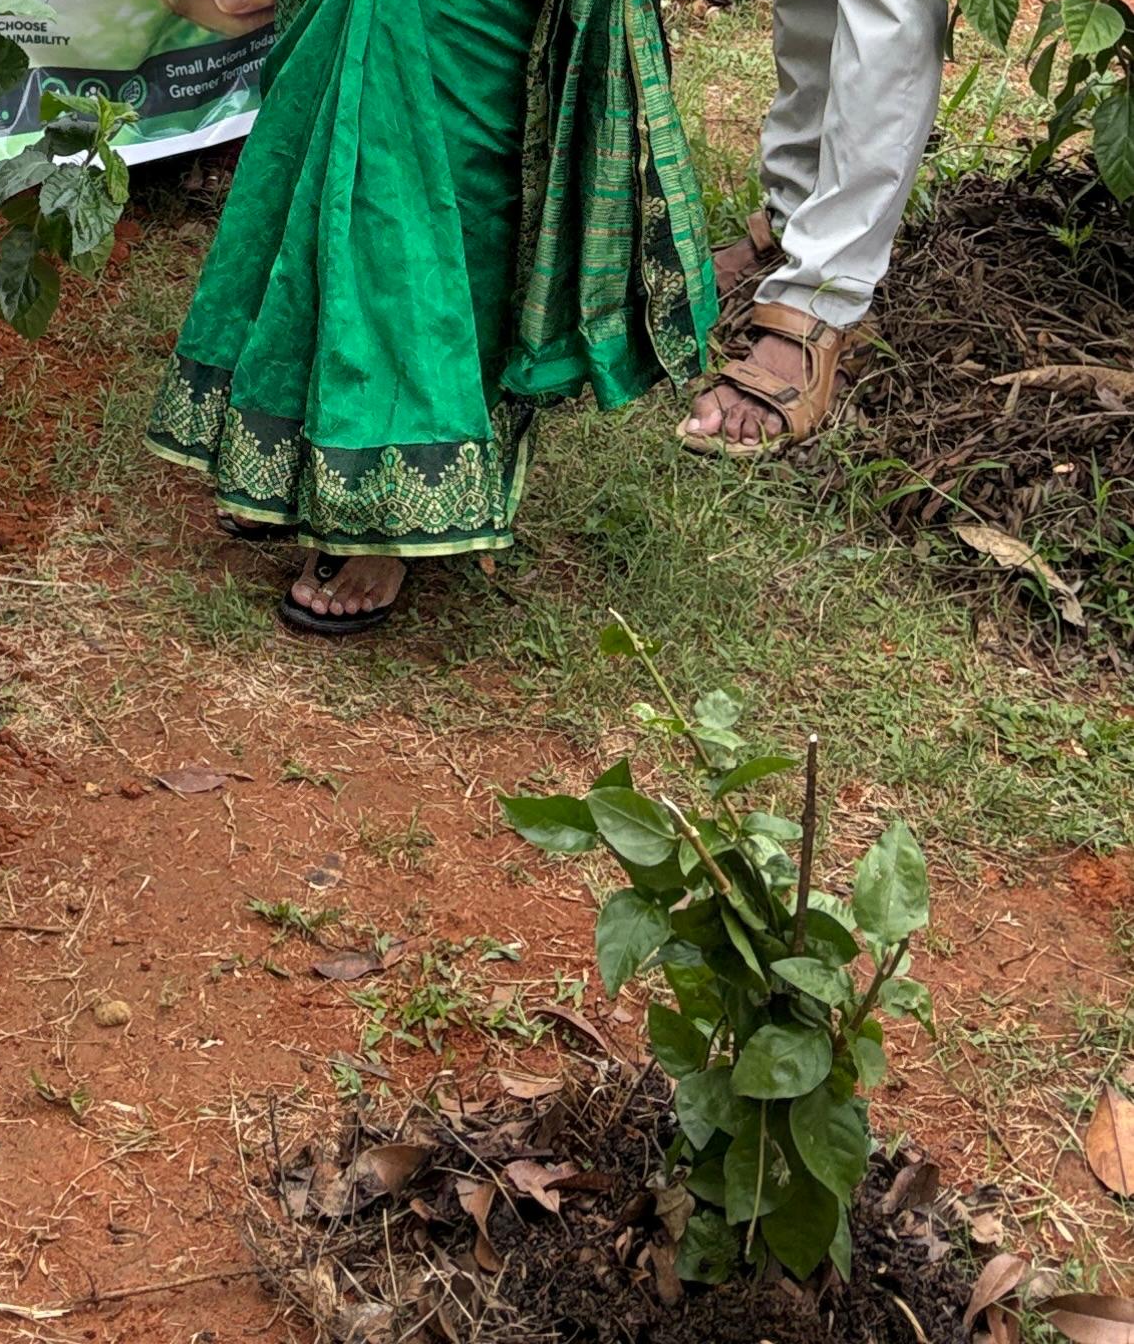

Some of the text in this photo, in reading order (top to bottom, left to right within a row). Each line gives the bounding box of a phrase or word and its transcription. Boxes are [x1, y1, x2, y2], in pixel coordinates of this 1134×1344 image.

[165, 58, 204, 78] Small
[206, 47, 248, 72] Actions
[169, 75, 220, 99] Greener
